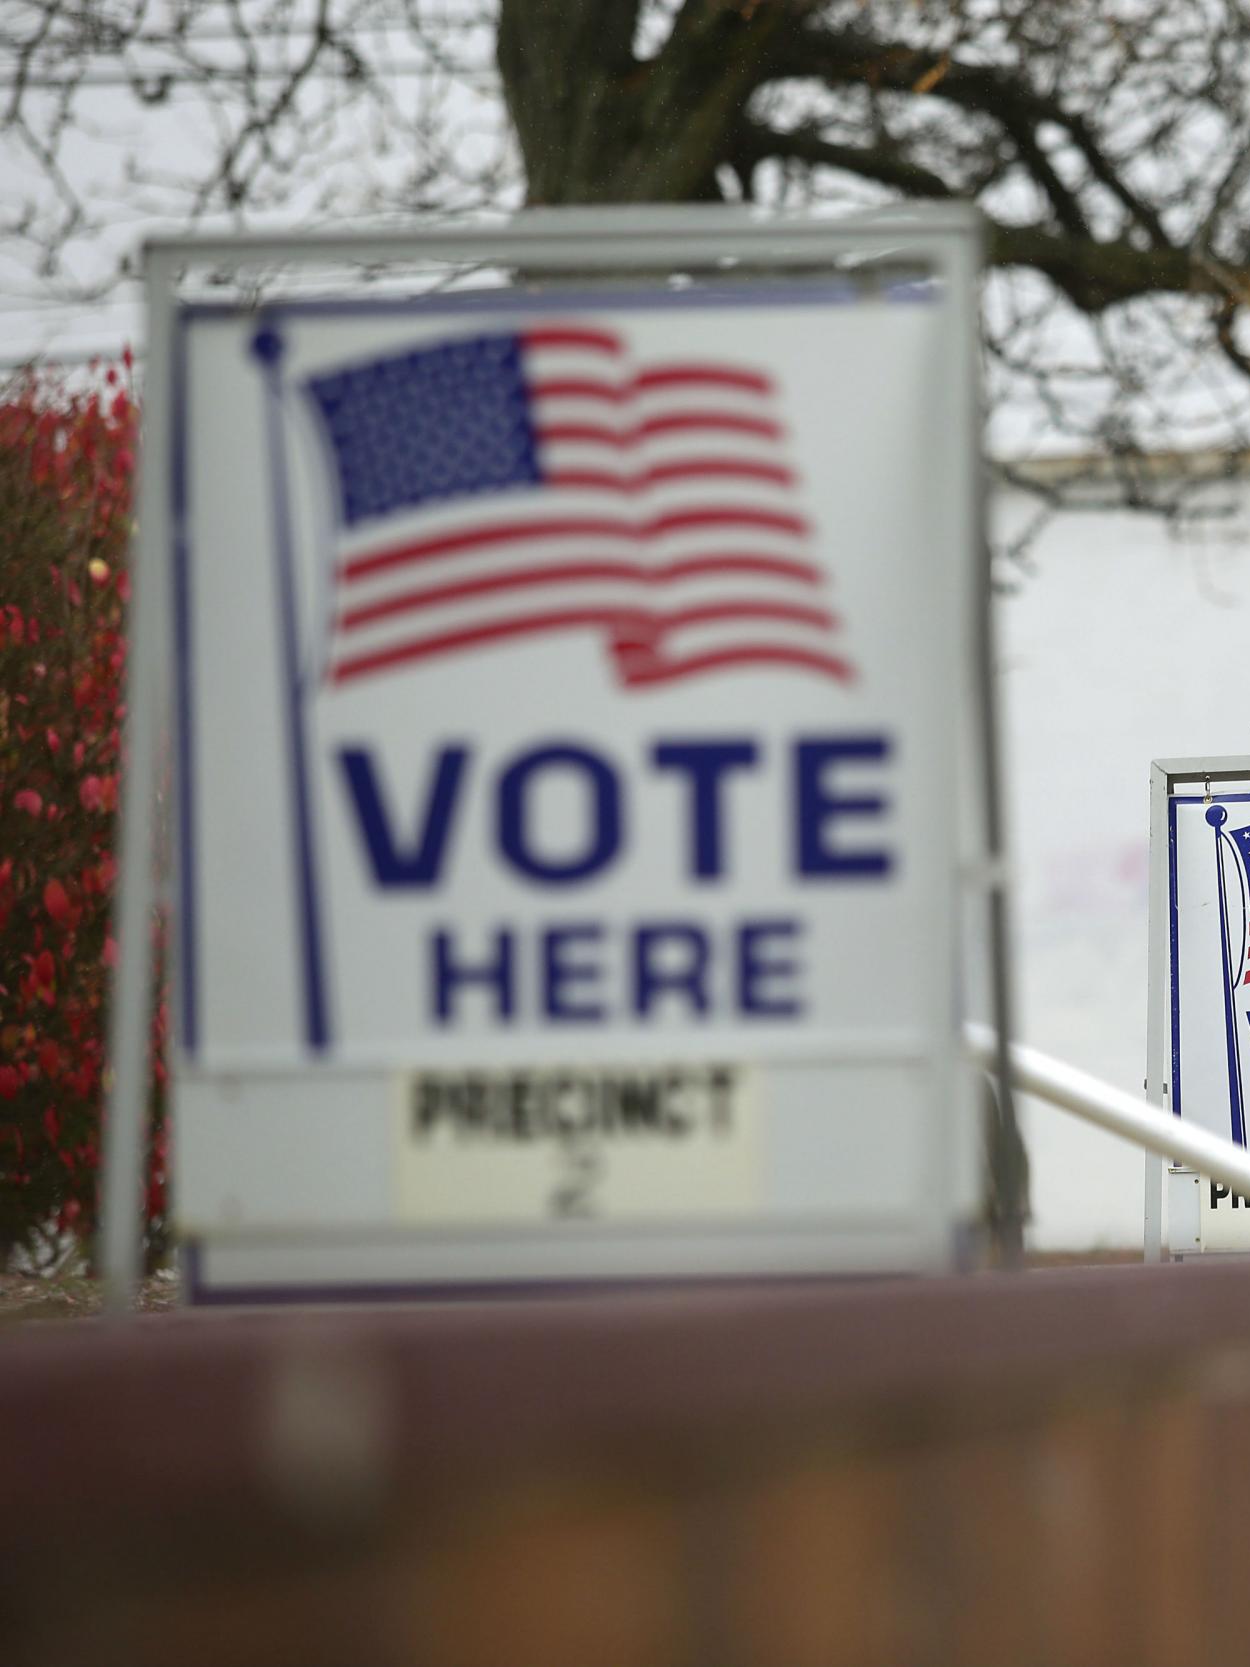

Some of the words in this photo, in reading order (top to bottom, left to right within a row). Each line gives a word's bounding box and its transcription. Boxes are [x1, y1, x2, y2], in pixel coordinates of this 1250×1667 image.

[334, 735, 894, 892] VOTE
[429, 918, 804, 1026] HERE
[411, 1068, 738, 1142] PRECINCT
[548, 1148, 607, 1219] 2
